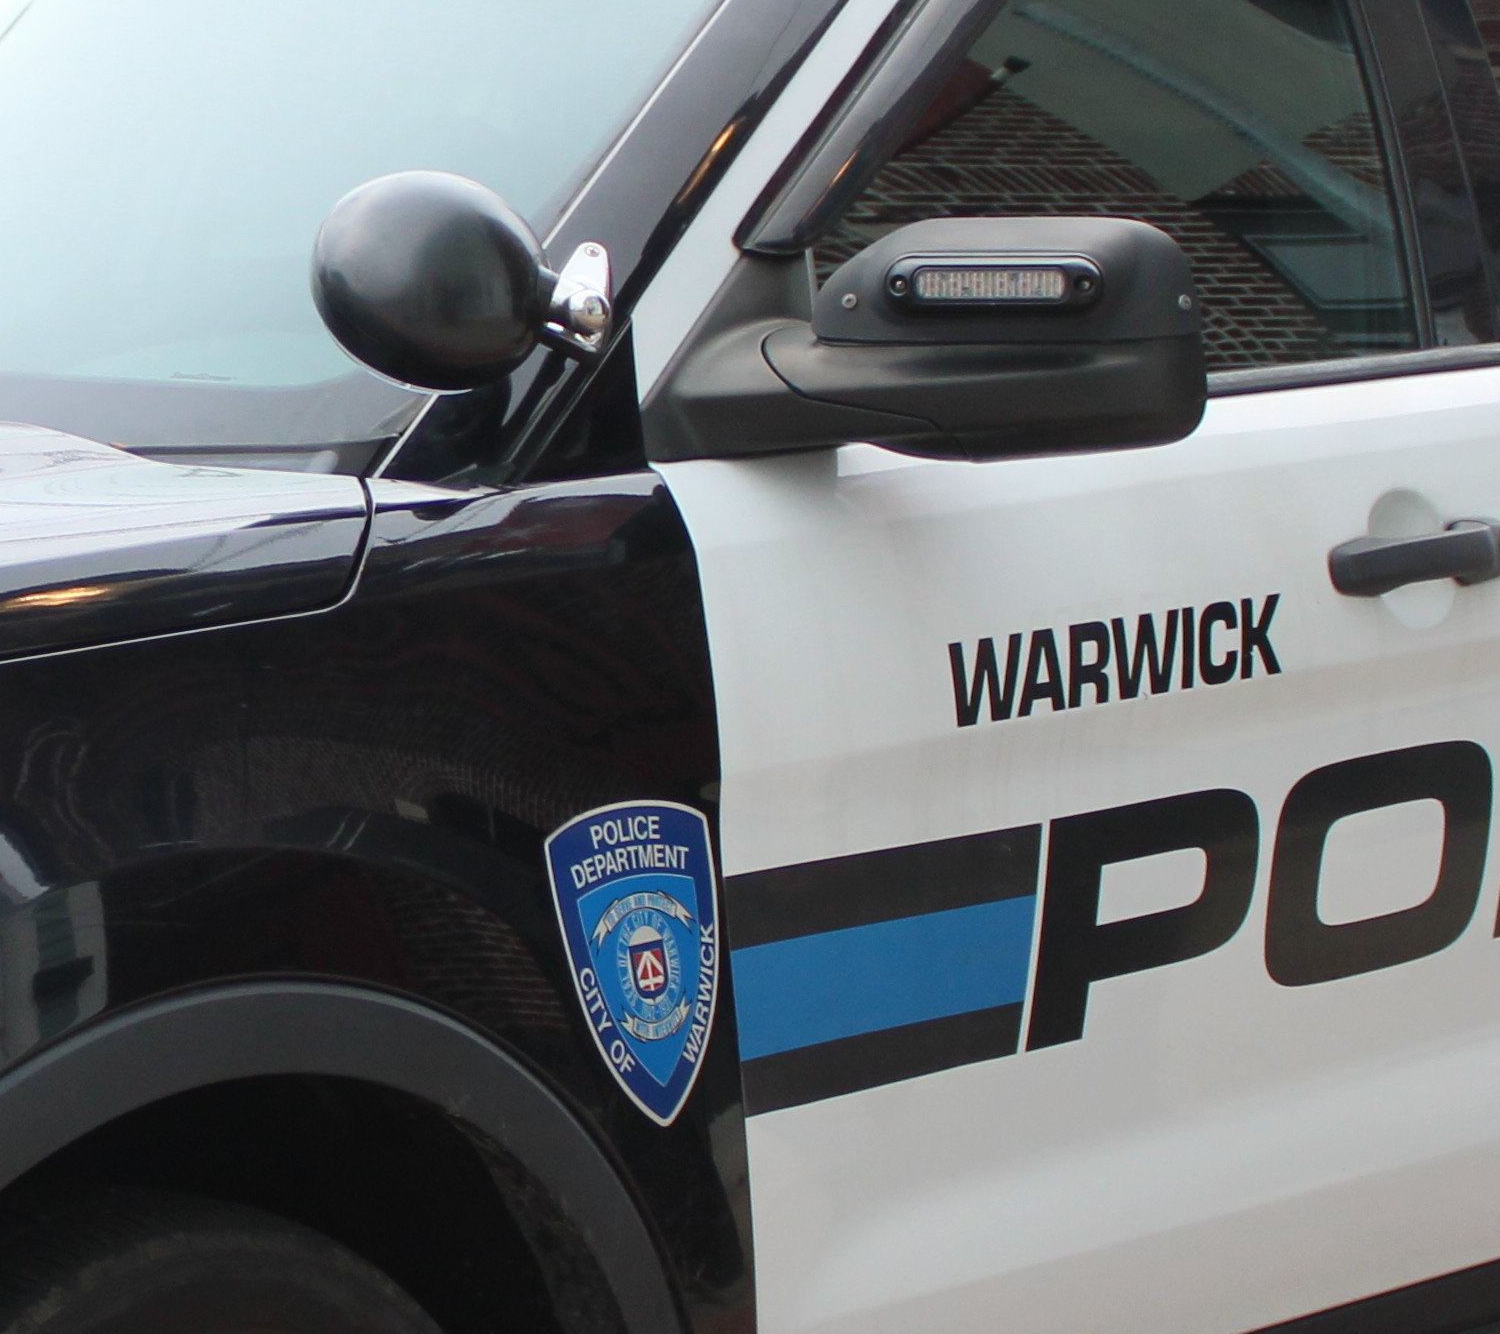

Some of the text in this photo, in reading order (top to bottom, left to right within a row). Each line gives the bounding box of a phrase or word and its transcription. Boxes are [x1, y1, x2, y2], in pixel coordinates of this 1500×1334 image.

[947, 593, 1282, 727] WARWICK
[569, 844, 690, 890] DEPARTMENT
[590, 816, 661, 849] POLICE
[580, 968, 613, 1032] CITY
[610, 1040, 636, 1073] OF
[682, 922, 714, 1064] WARWICK
